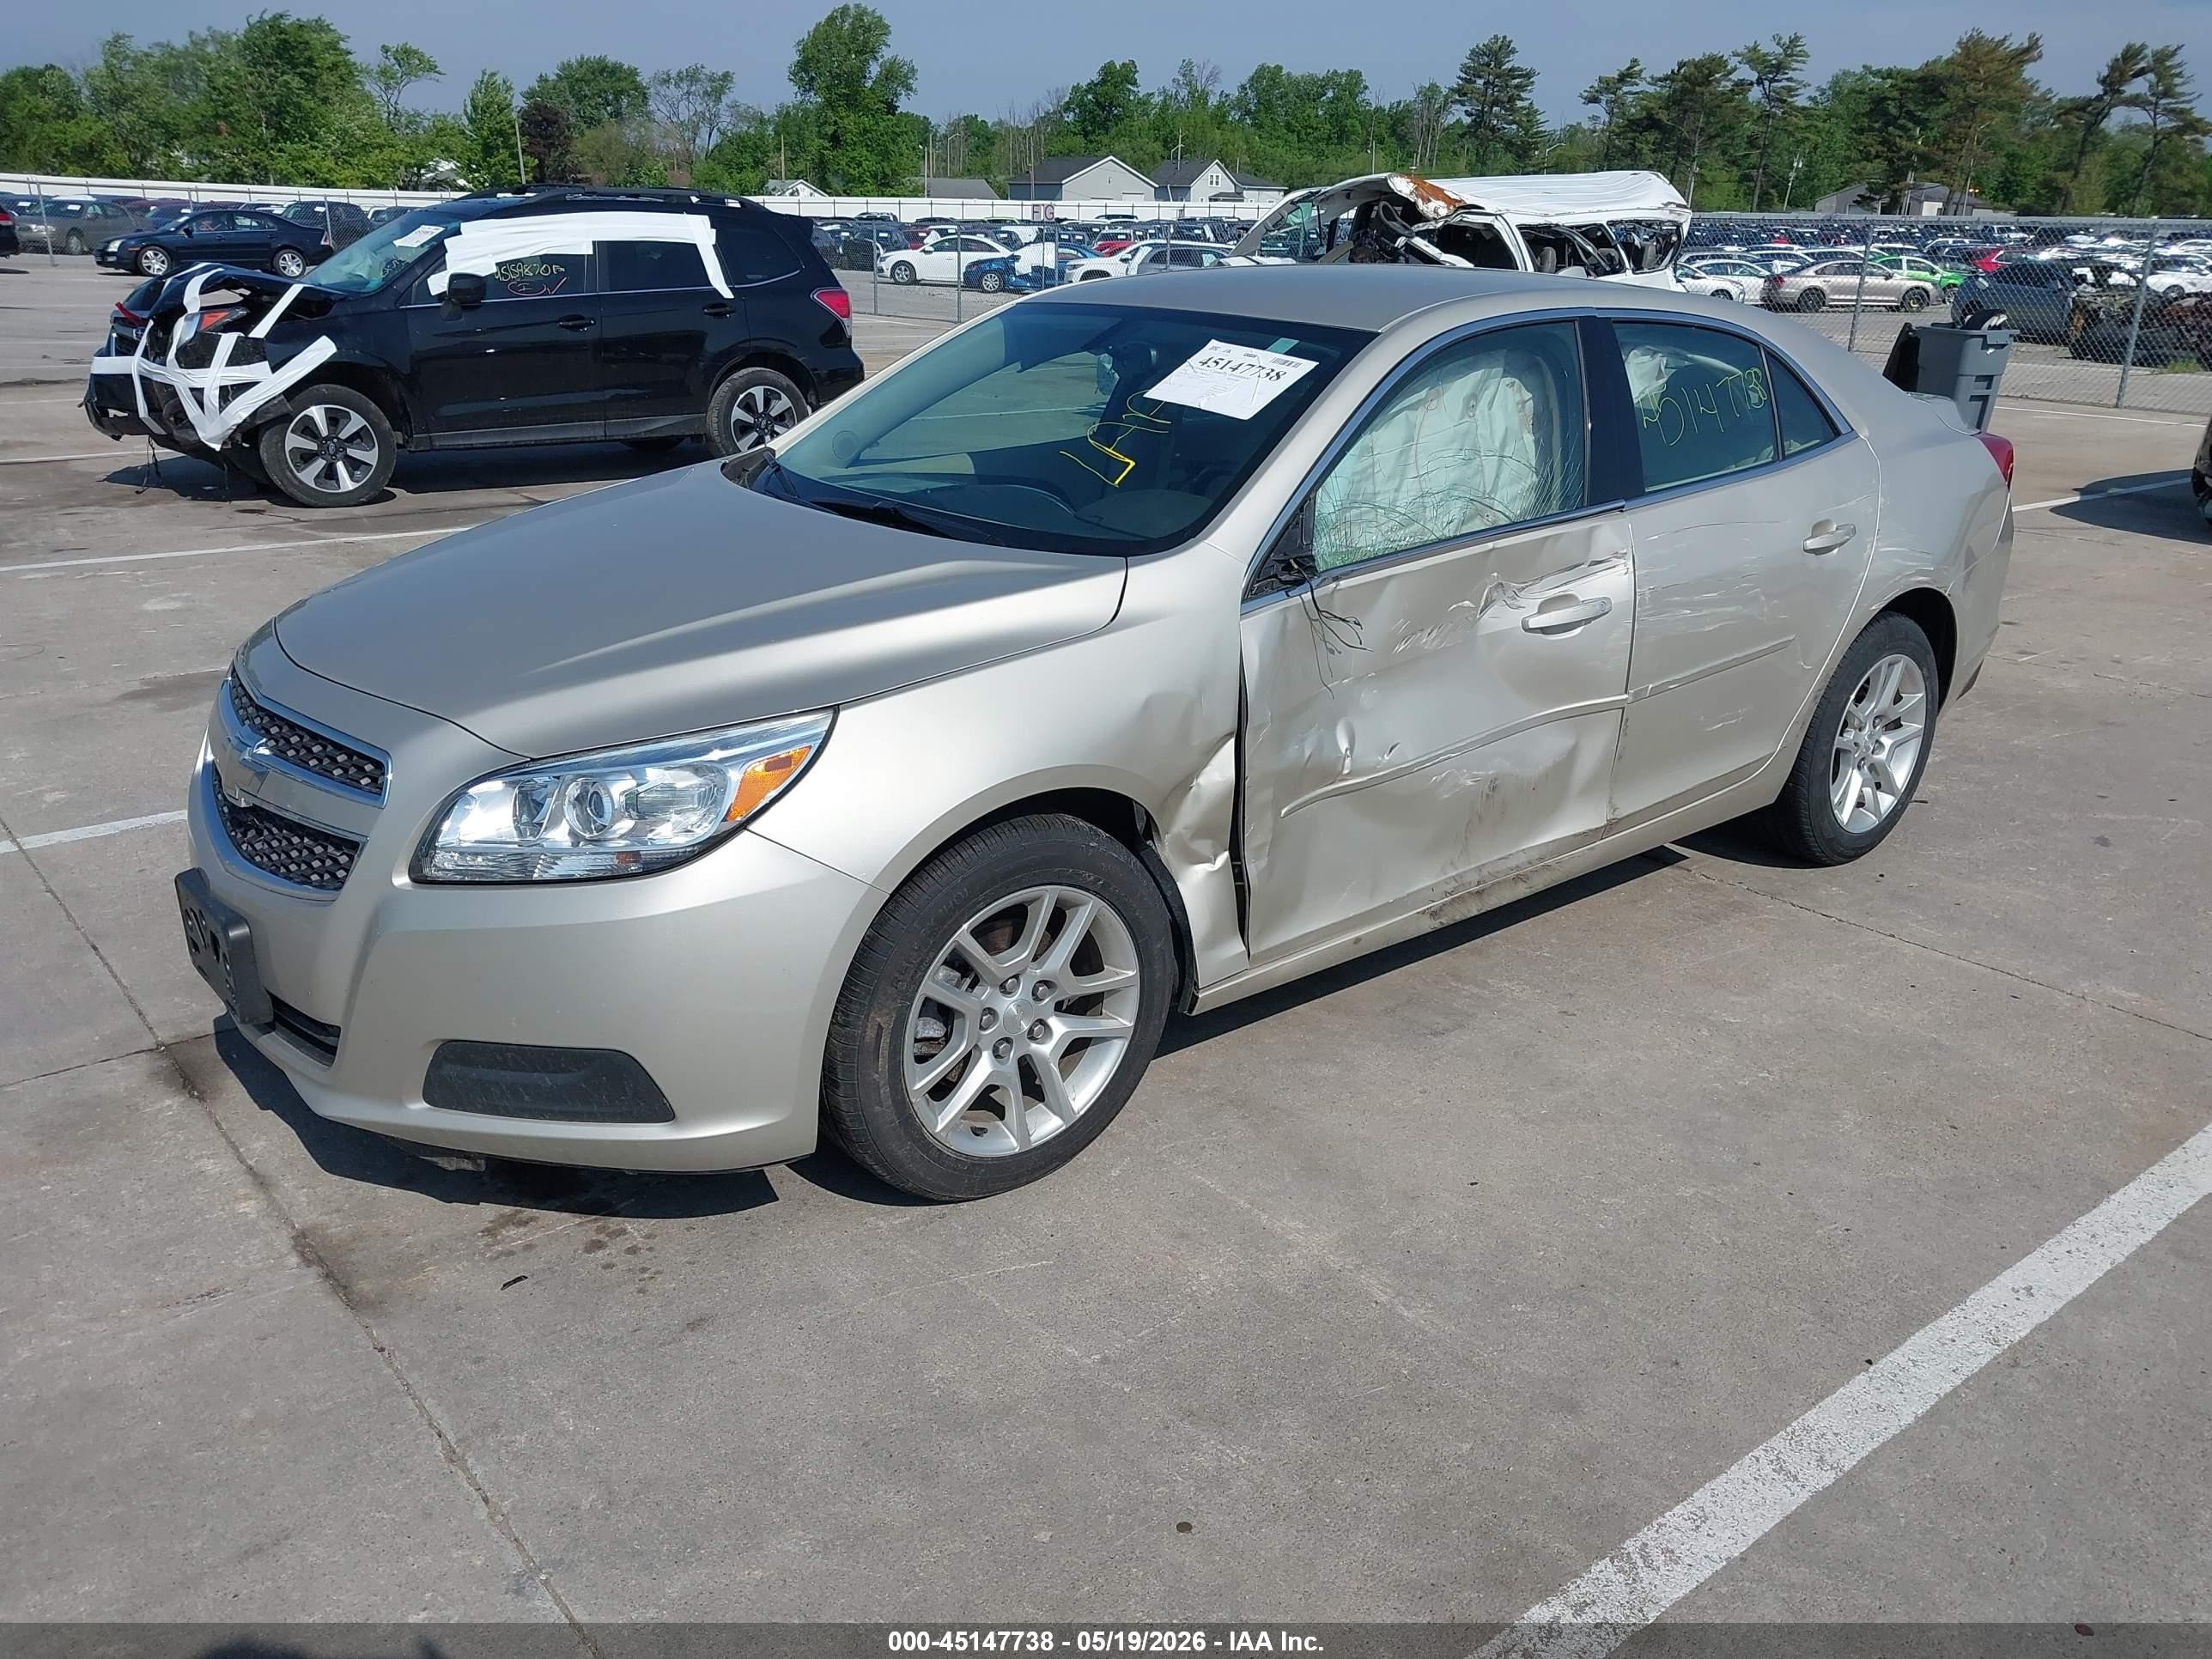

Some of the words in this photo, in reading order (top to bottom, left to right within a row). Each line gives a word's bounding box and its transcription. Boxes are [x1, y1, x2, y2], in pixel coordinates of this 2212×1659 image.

[1044, 204, 1054, 221] G
[1198, 356, 1286, 382] 45147738
[1639, 367, 1767, 447] 45147738
